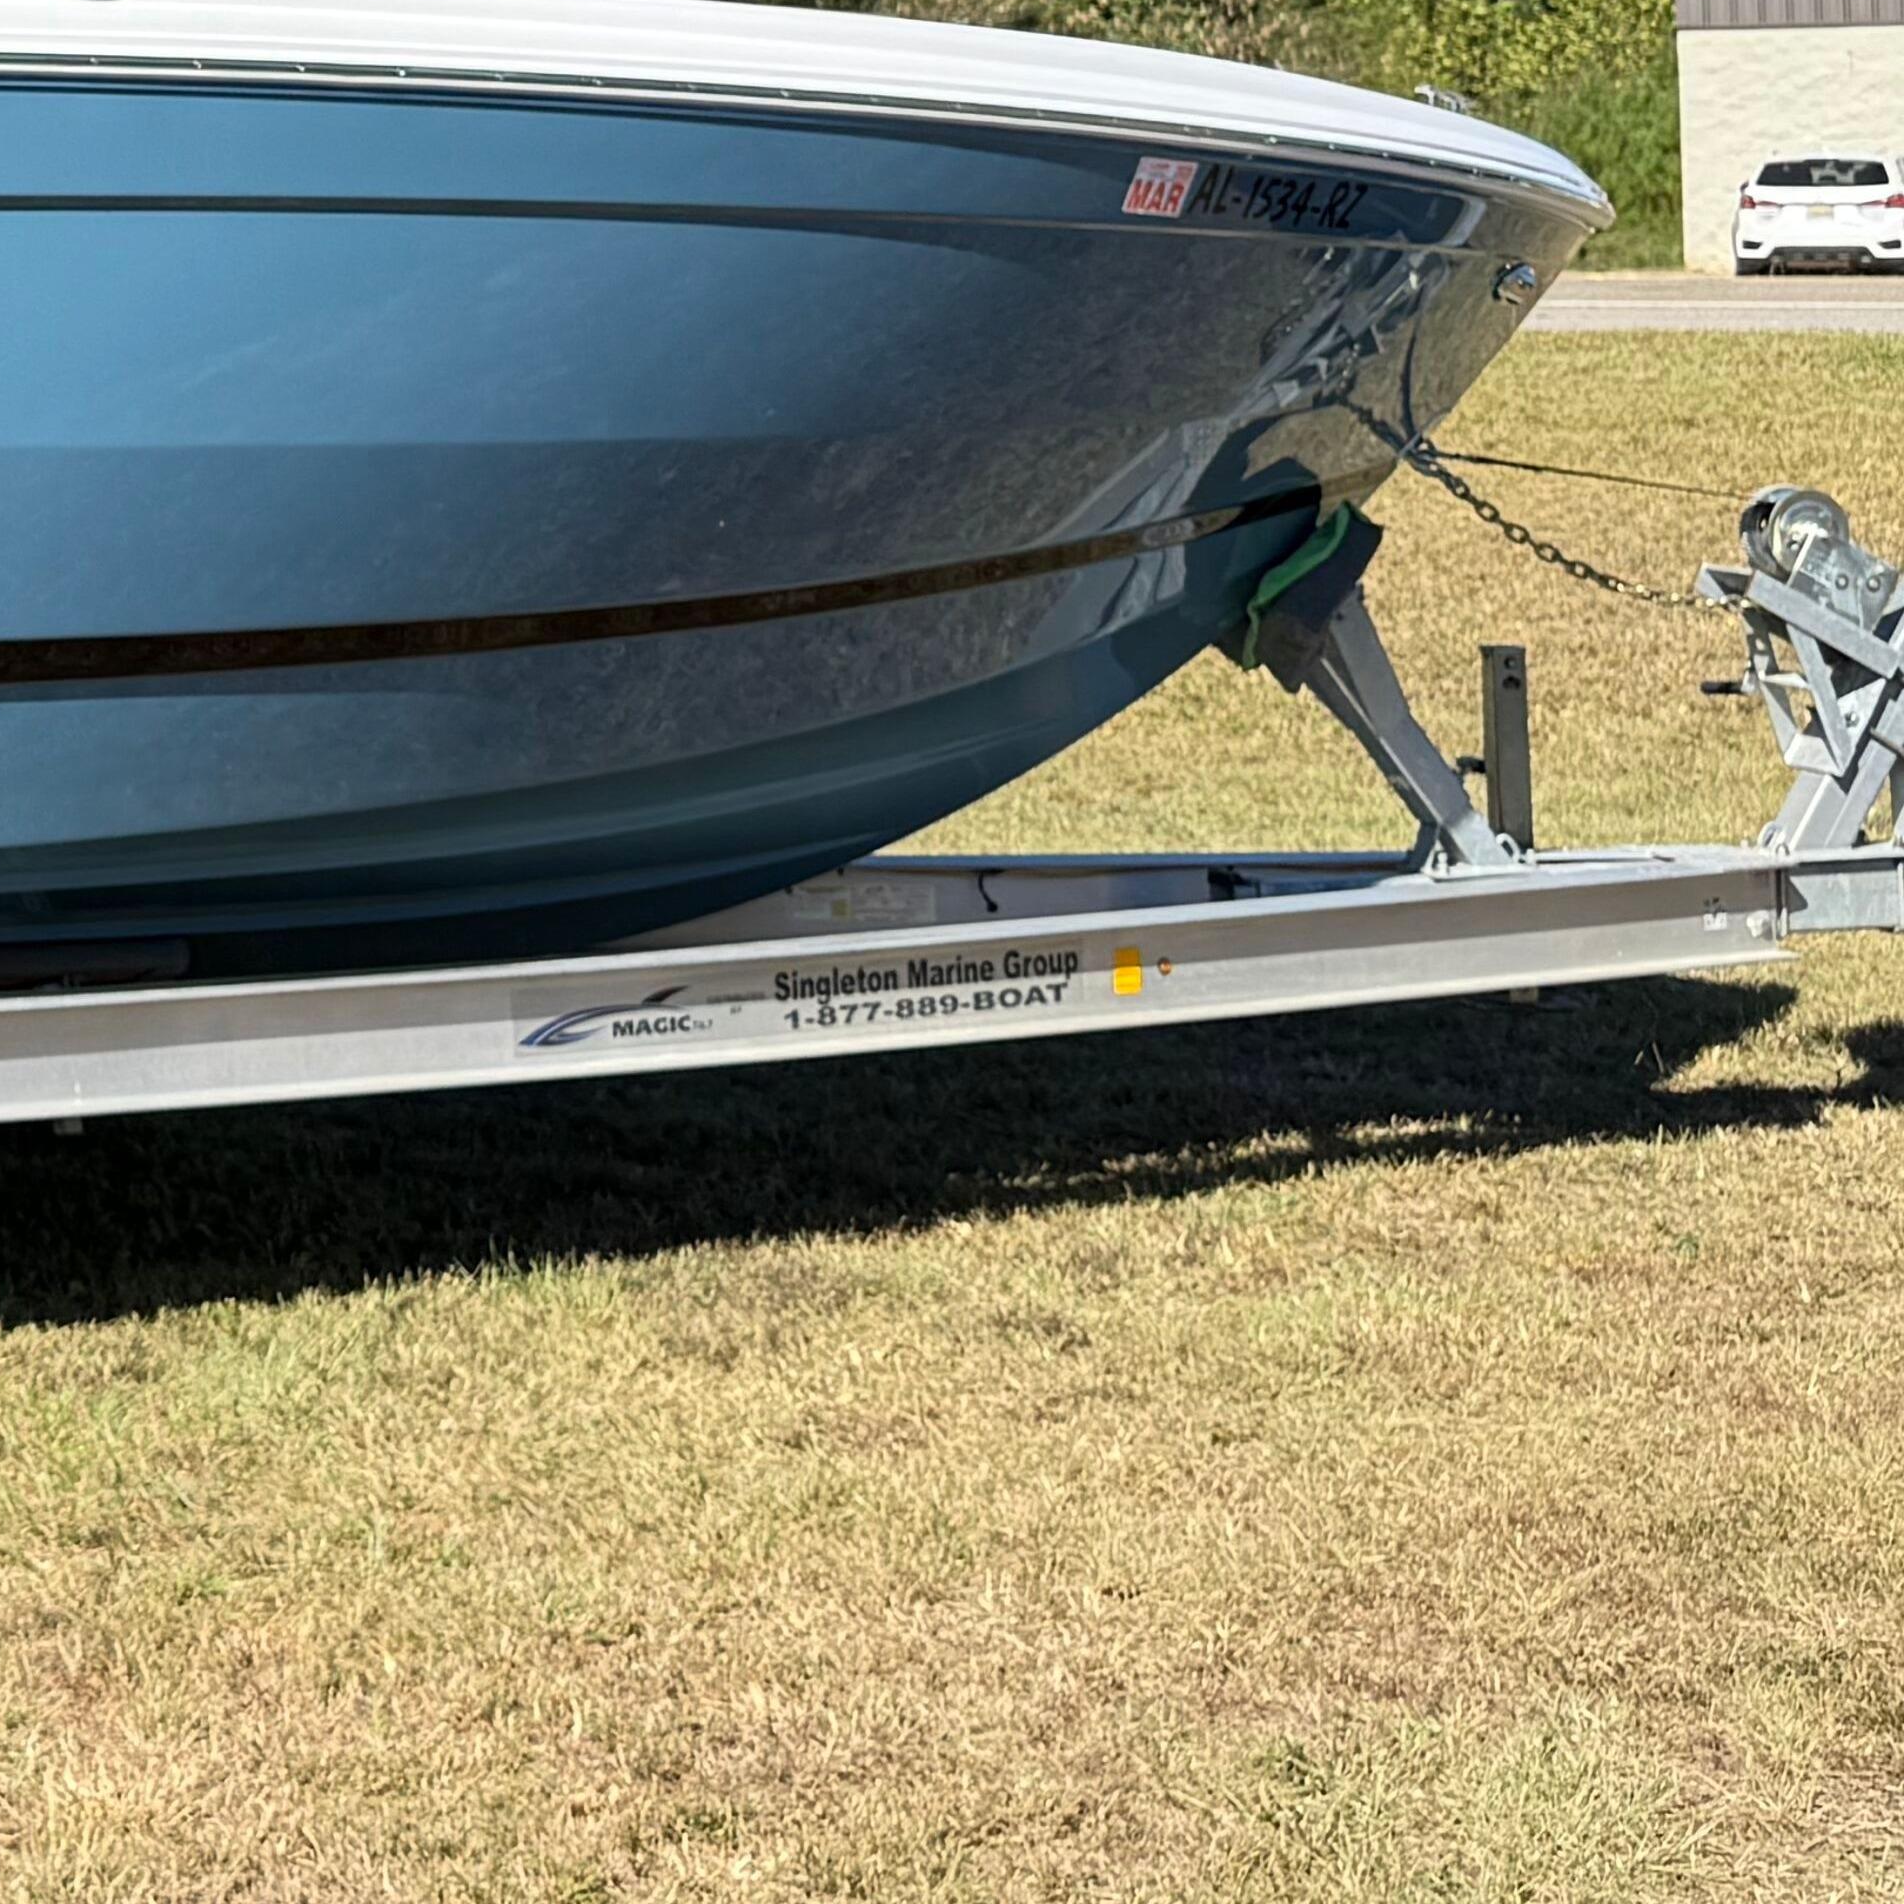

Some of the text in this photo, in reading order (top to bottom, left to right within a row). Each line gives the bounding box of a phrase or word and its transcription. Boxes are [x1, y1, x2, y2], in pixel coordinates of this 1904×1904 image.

[1127, 178, 1185, 213] MAR
[774, 949, 1079, 1005] Singleton Marine Group
[611, 1014, 691, 1038] MAGIC
[784, 981, 1069, 1030] 1-877-889-BOAT
